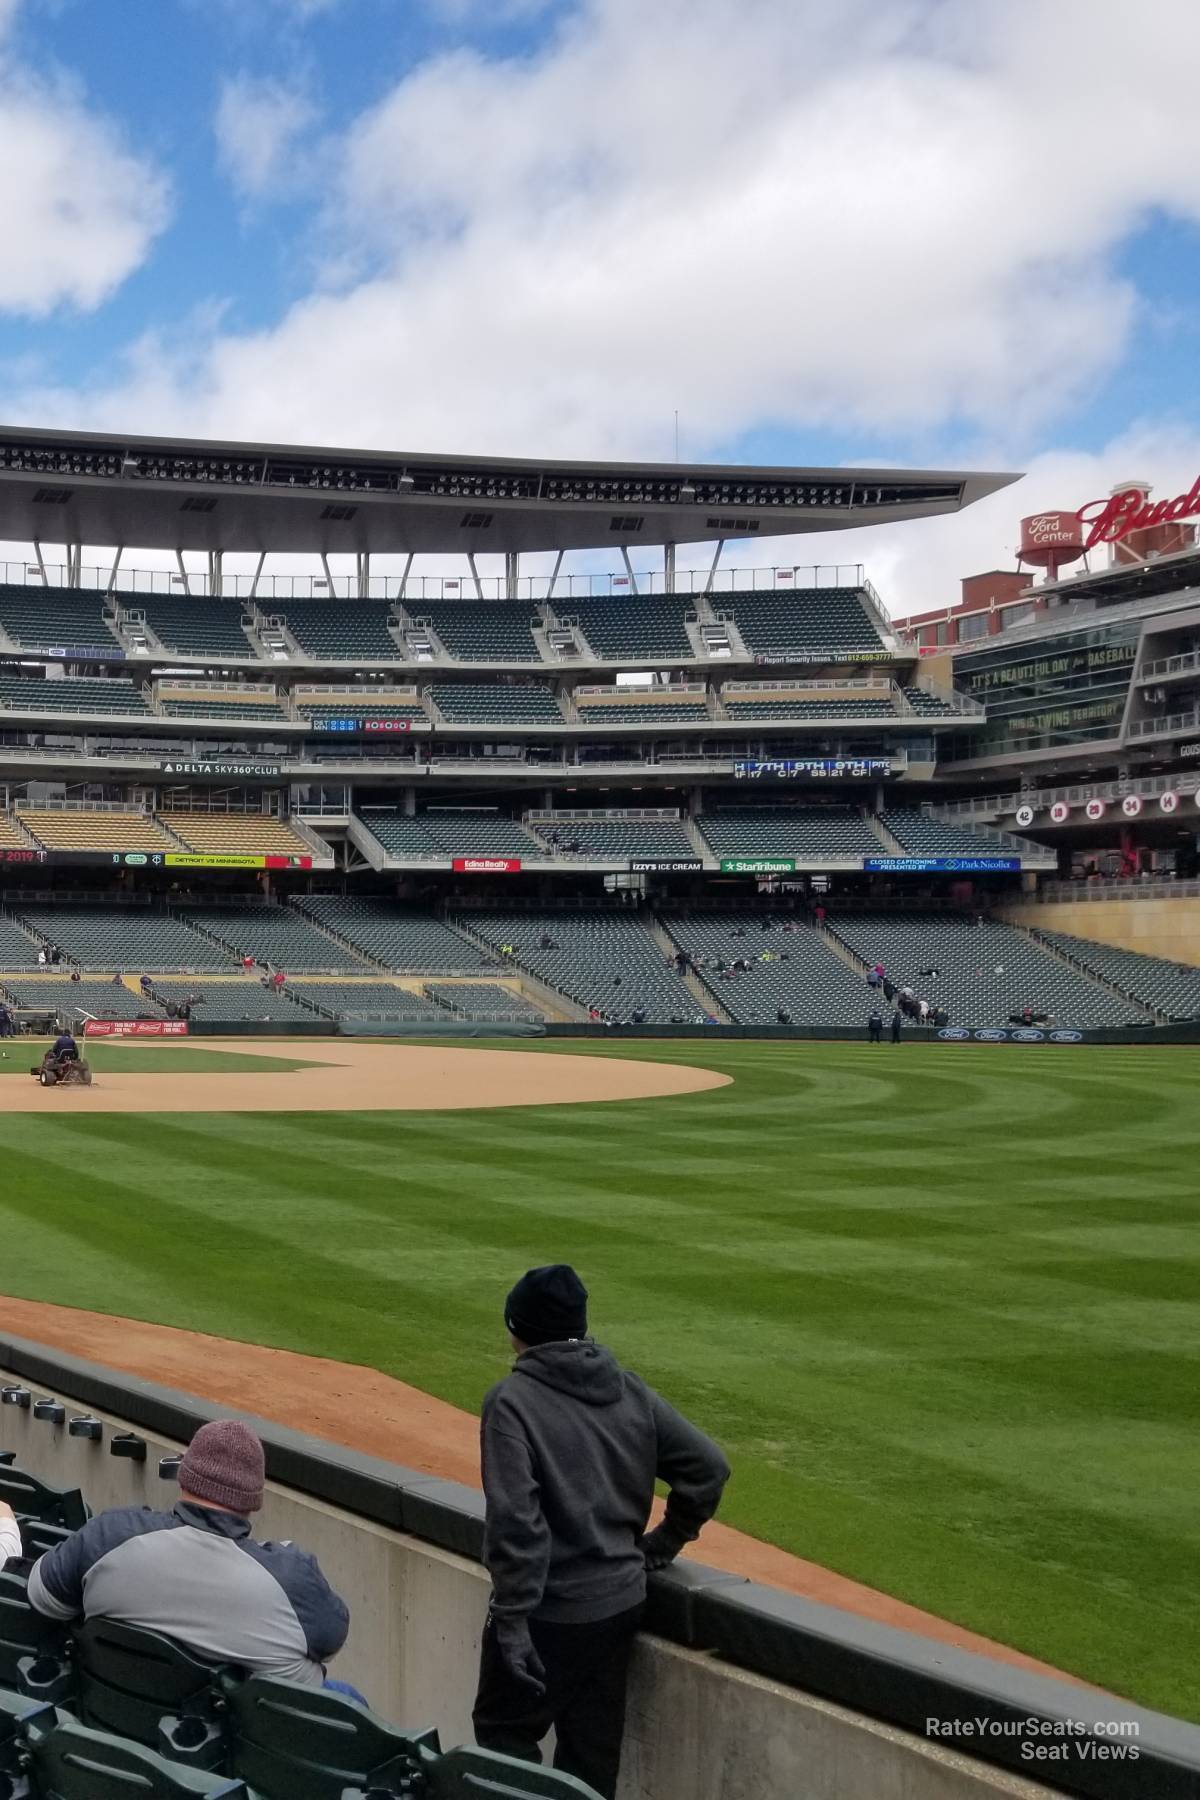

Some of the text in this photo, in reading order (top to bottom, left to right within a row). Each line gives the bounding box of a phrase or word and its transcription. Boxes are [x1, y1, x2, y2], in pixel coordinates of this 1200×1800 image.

[1028, 515, 1060, 535] Ford
[1033, 530, 1074, 544] Center
[764, 656, 784, 665] Report
[785, 655, 810, 664] Security
[993, 671, 999, 685] A
[1000, 662, 1050, 683] BEAUTIFUL
[1051, 658, 1069, 673] DAY
[1087, 646, 1137, 667] BASEBALL
[1036, 711, 1070, 729] TWINS
[1072, 704, 1117, 720] TERRITORY
[175, 763, 211, 773] DELTA
[754, 762, 785, 771] 7TH
[794, 761, 824, 770] 8TH
[835, 761, 865, 770] 9TH
[852, 769, 868, 777] CF
[1125, 801, 1138, 812] 34
[1019, 811, 1030, 821] 42
[7, 851, 33, 862] 2019
[464, 860, 485, 868] Edina
[658, 863, 671, 871] ICE
[672, 863, 702, 871] CREAM
[735, 861, 792, 872] StarTribune
[960, 859, 1012, 869] Park Nicollet
[944, 1030, 964, 1039] Ford
[980, 1031, 1000, 1040] Ford
[1017, 1031, 1037, 1040] Ford
[1055, 1032, 1076, 1041] Ford
